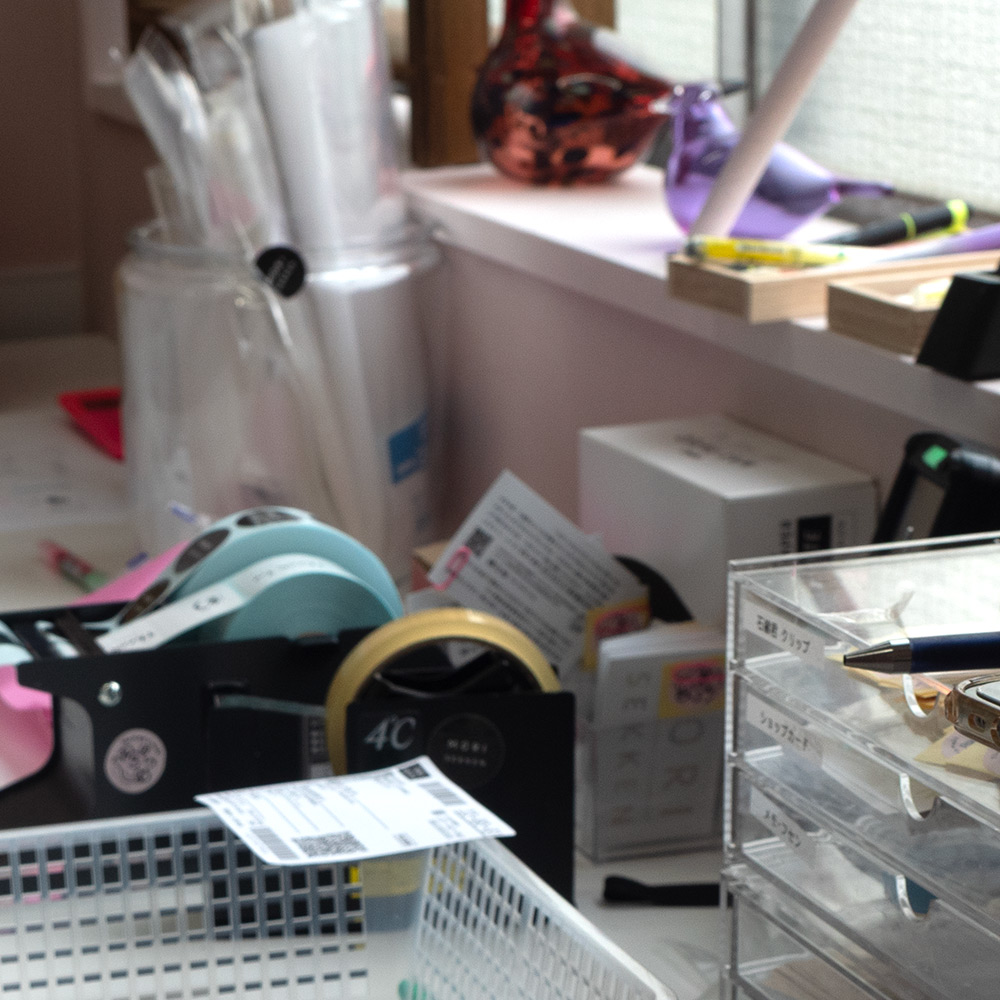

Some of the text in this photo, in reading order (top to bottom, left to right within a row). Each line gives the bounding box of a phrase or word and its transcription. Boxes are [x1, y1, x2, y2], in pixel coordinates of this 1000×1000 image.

[781, 629, 811, 654] クリップ
[760, 711, 808, 750] ショップカード
